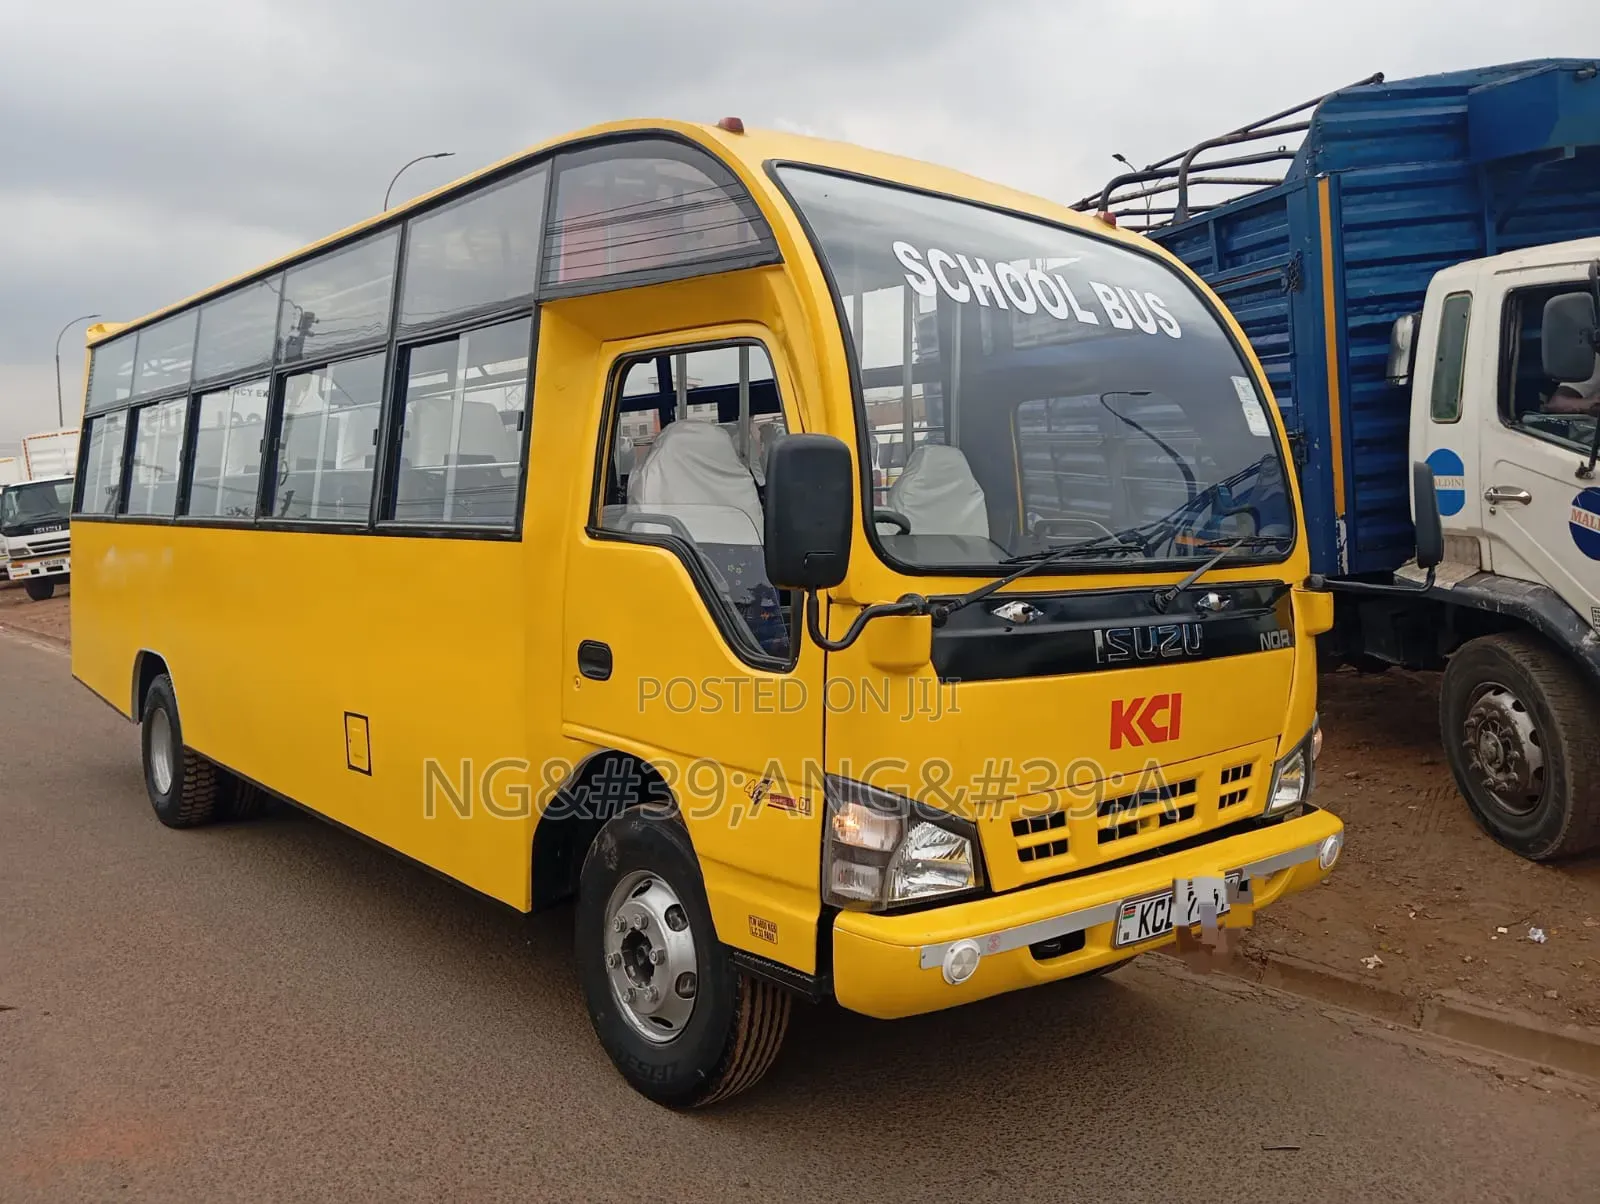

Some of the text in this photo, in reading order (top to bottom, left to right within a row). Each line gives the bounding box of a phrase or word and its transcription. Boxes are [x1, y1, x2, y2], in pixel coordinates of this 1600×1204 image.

[893, 241, 1181, 338] SCHOOL BUS
[34, 524, 62, 534] ISUZU
[1571, 508, 1600, 531] MAL
[1094, 624, 1203, 664] ISUZU
[1260, 630, 1291, 650] NQR
[1110, 693, 1182, 750] KCI
